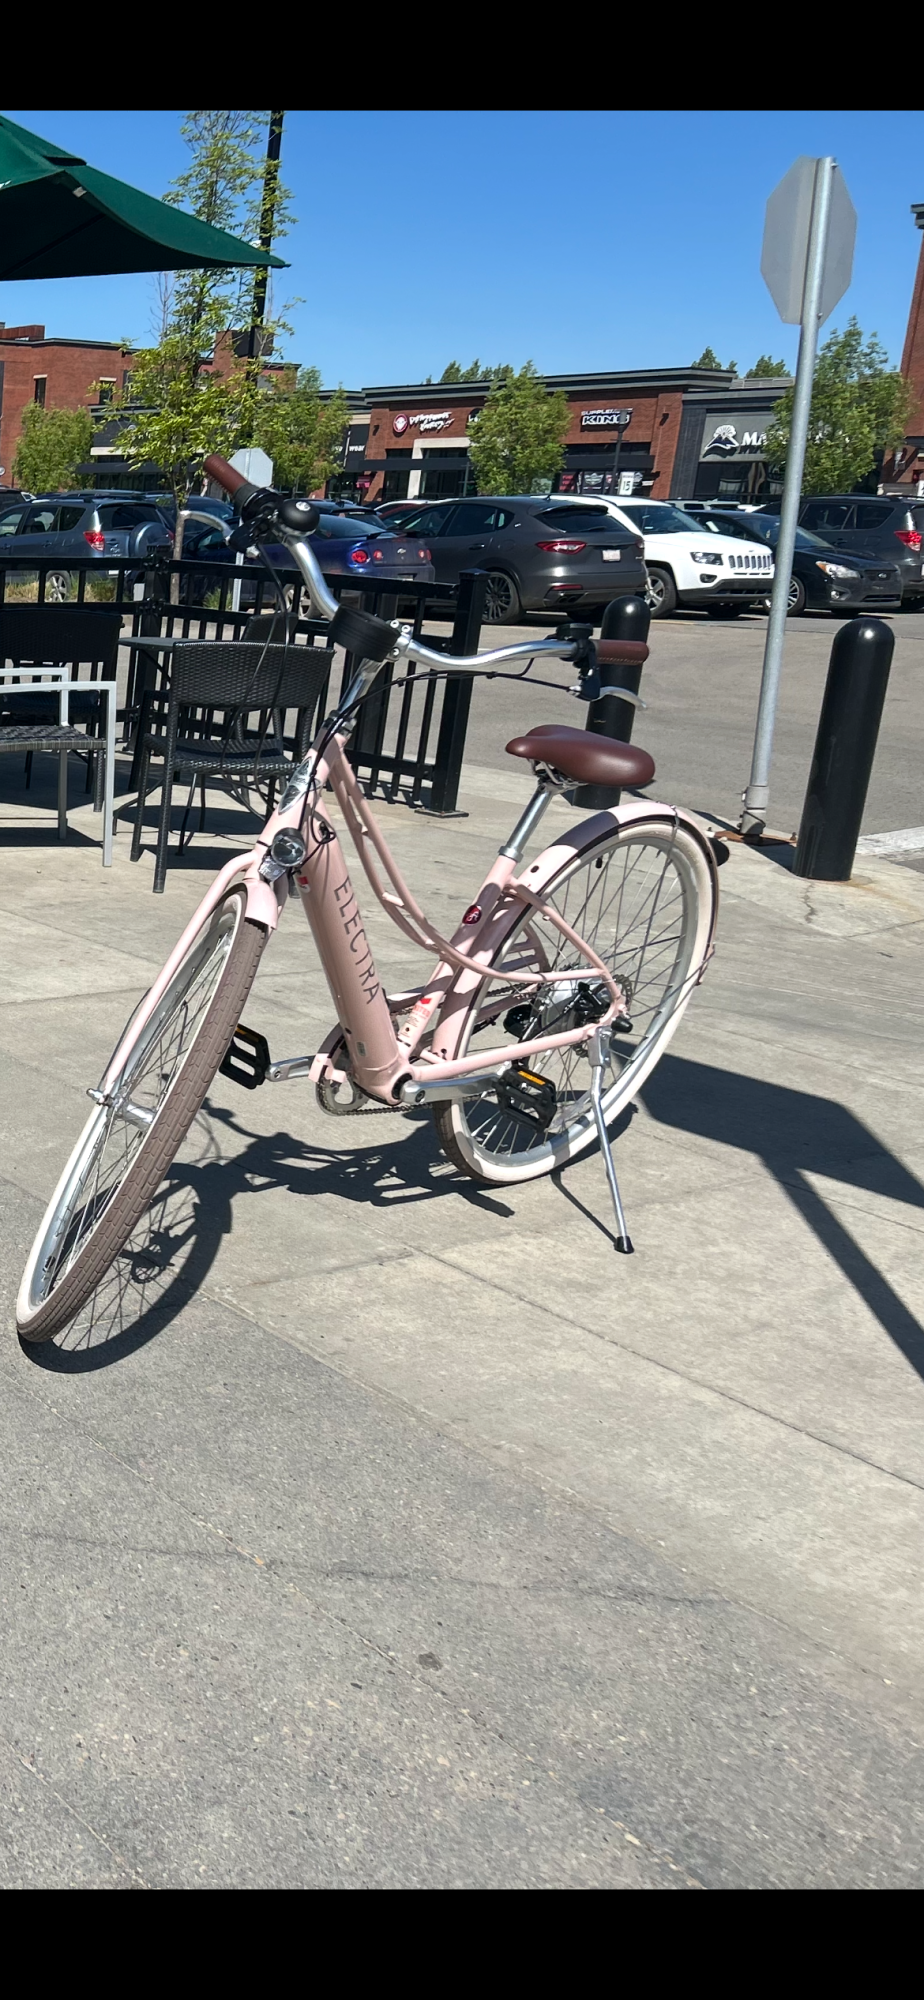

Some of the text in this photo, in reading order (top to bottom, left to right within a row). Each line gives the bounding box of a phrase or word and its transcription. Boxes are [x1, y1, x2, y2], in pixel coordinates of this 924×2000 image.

[581, 408, 633, 416] SUPPLEMT
[582, 414, 630, 425] KING
[623, 480, 631, 491] 15
[333, 875, 380, 1005] ELECTRA
